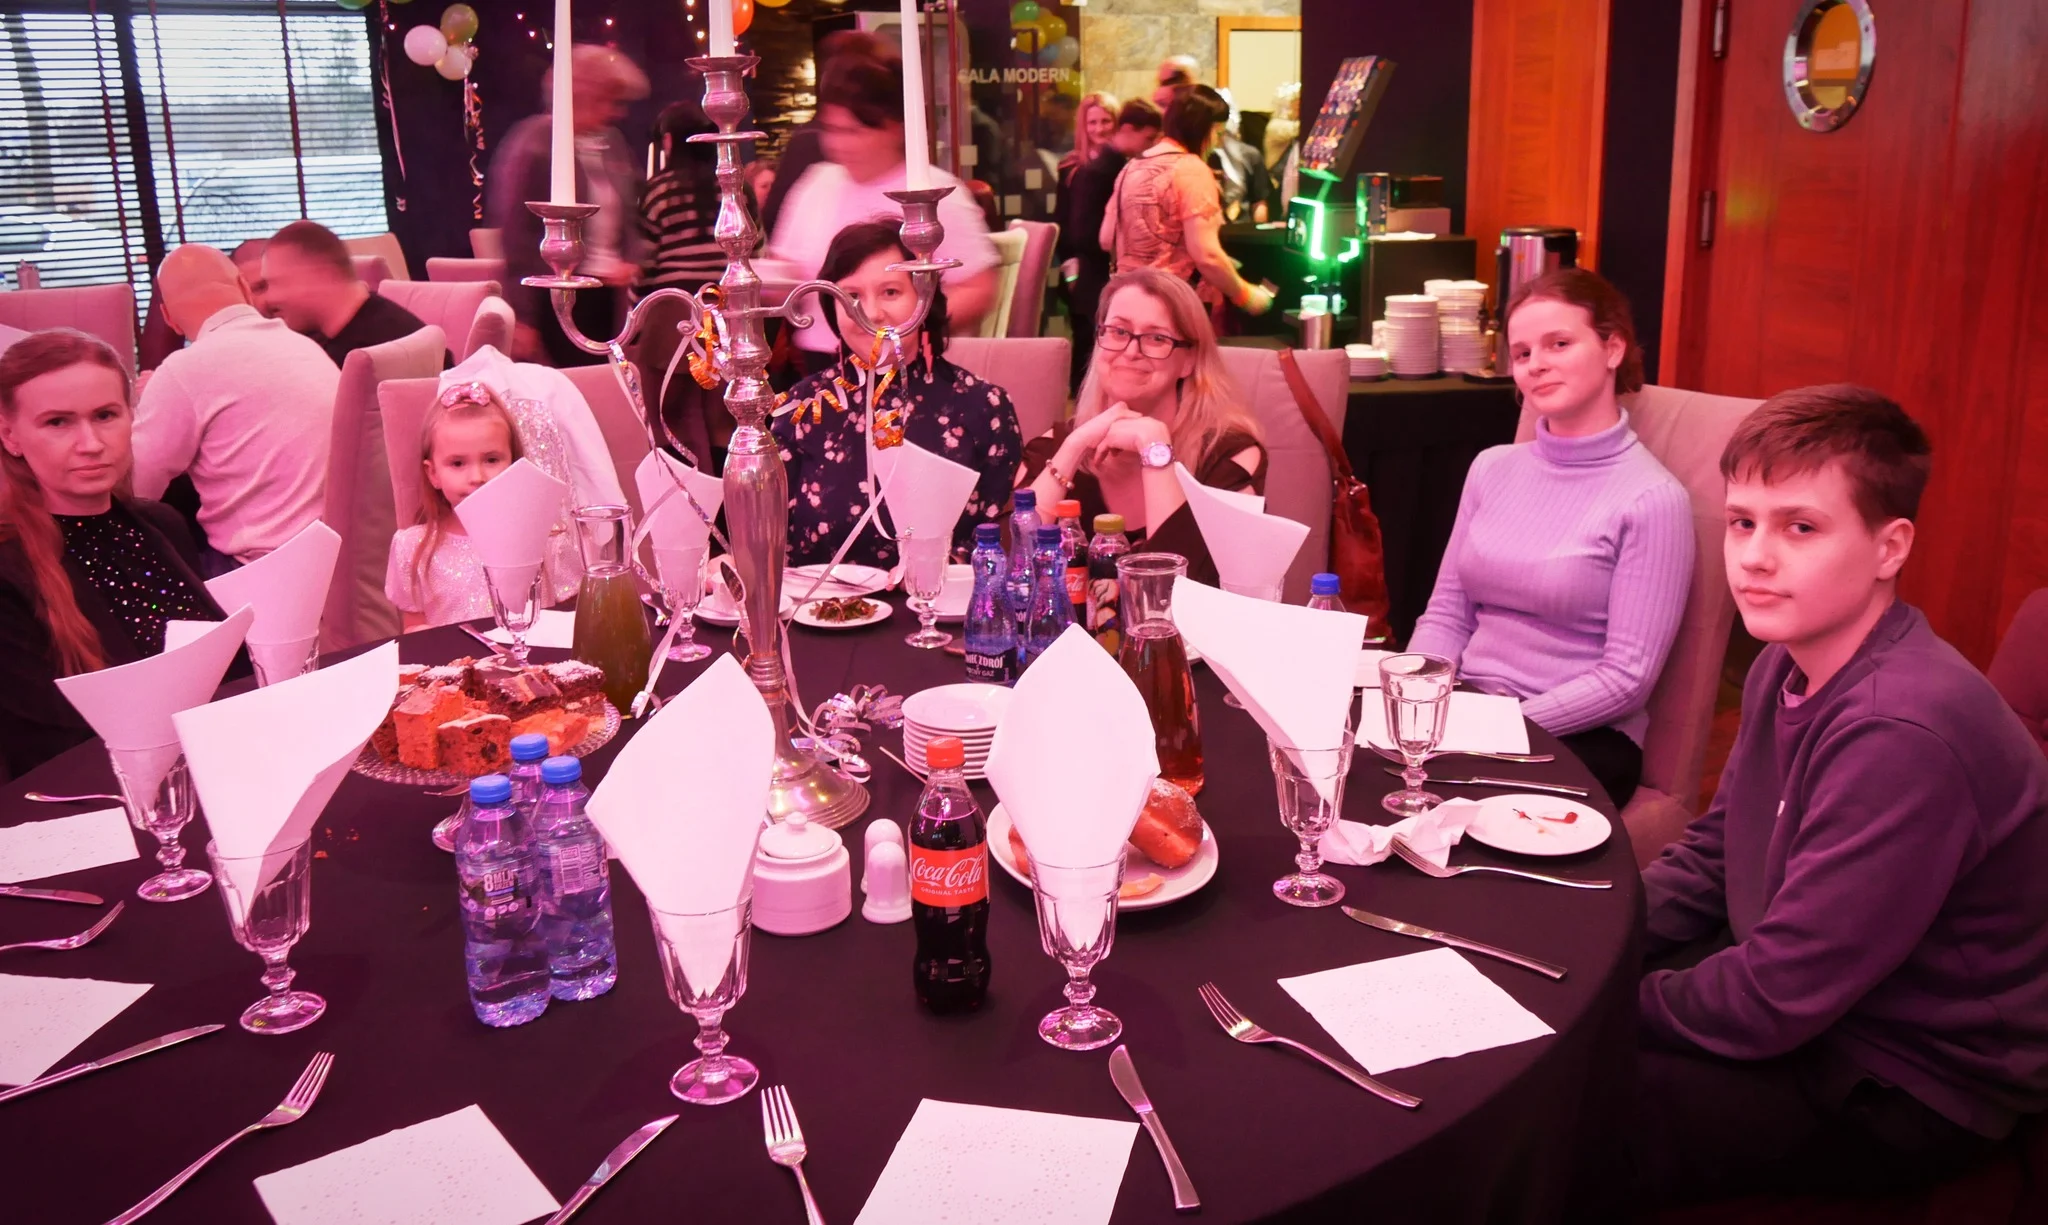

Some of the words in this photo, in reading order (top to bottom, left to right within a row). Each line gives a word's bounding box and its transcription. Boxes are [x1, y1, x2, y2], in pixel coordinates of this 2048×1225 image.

[1003, 67, 1070, 83] MODERN
[978, 655, 1003, 669] ZDRÓJ
[912, 853, 985, 888] Coca-Cola
[484, 873, 494, 892] 8
[920, 887, 952, 896] ORIGINAL
[954, 887, 975, 896] TASTE
